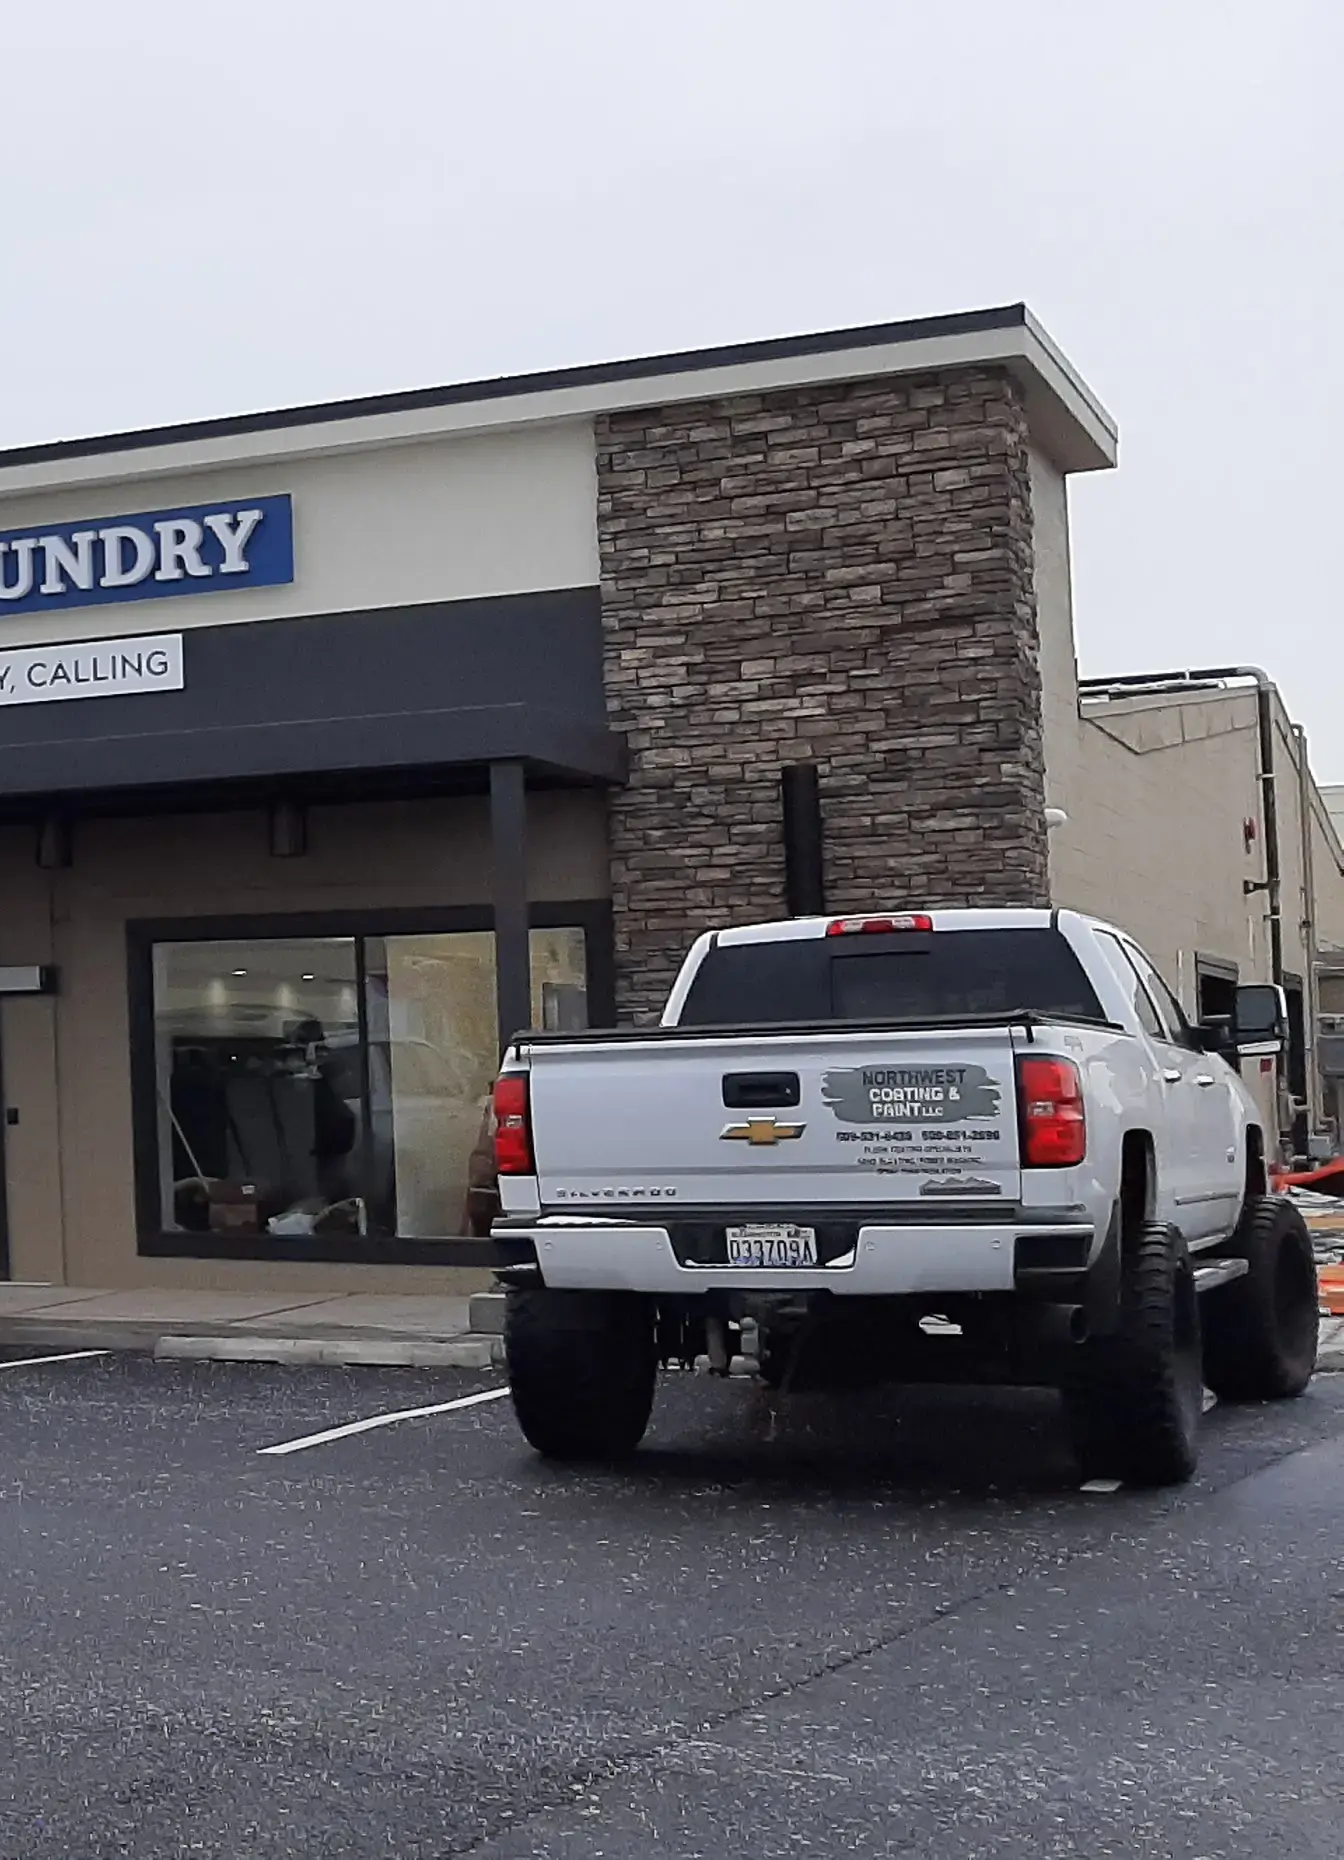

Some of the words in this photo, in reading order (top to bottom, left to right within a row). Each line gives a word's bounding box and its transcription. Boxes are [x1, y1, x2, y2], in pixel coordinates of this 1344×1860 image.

[26, 649, 170, 687] CALLING
[862, 1068, 967, 1086] NORTHWEST
[869, 1086, 944, 1102] COATING
[948, 1086, 961, 1101] &
[872, 1102, 921, 1118] PAINT
[922, 1106, 945, 1117] LLC
